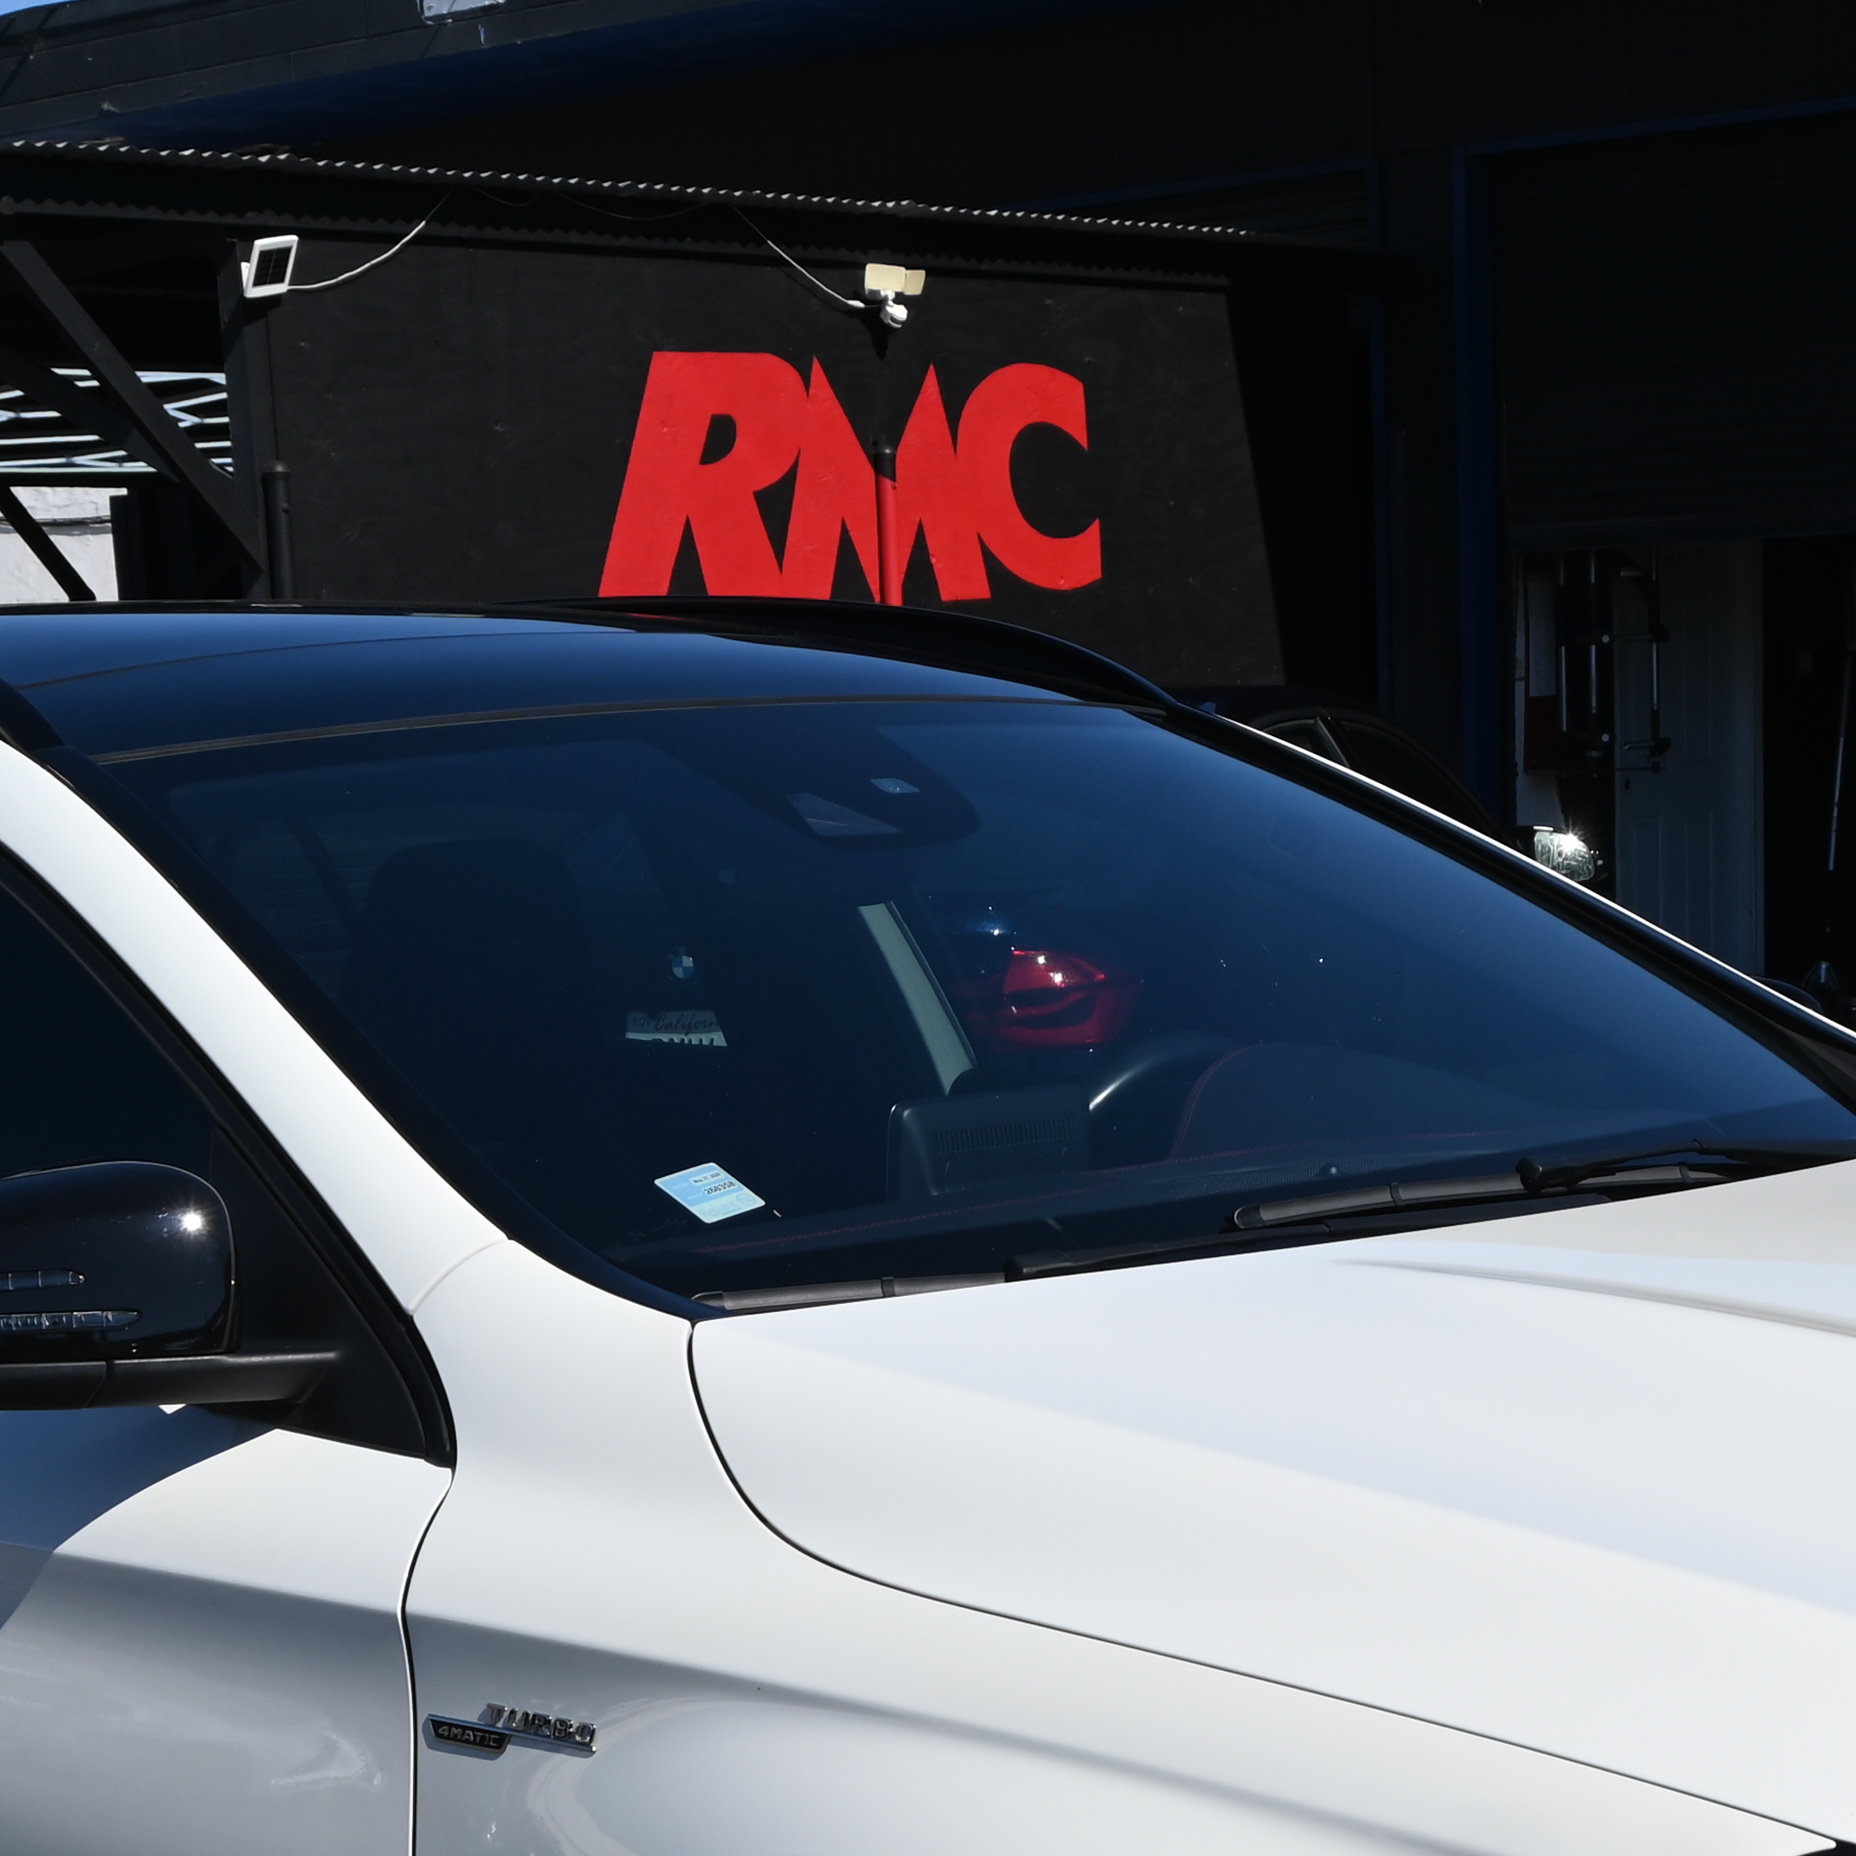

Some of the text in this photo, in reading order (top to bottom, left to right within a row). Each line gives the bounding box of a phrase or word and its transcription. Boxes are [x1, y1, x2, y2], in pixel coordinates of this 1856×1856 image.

[597, 349, 1103, 605] RMC
[437, 1724, 501, 1748] 4MATIC
[487, 1702, 597, 1747] TURBO
